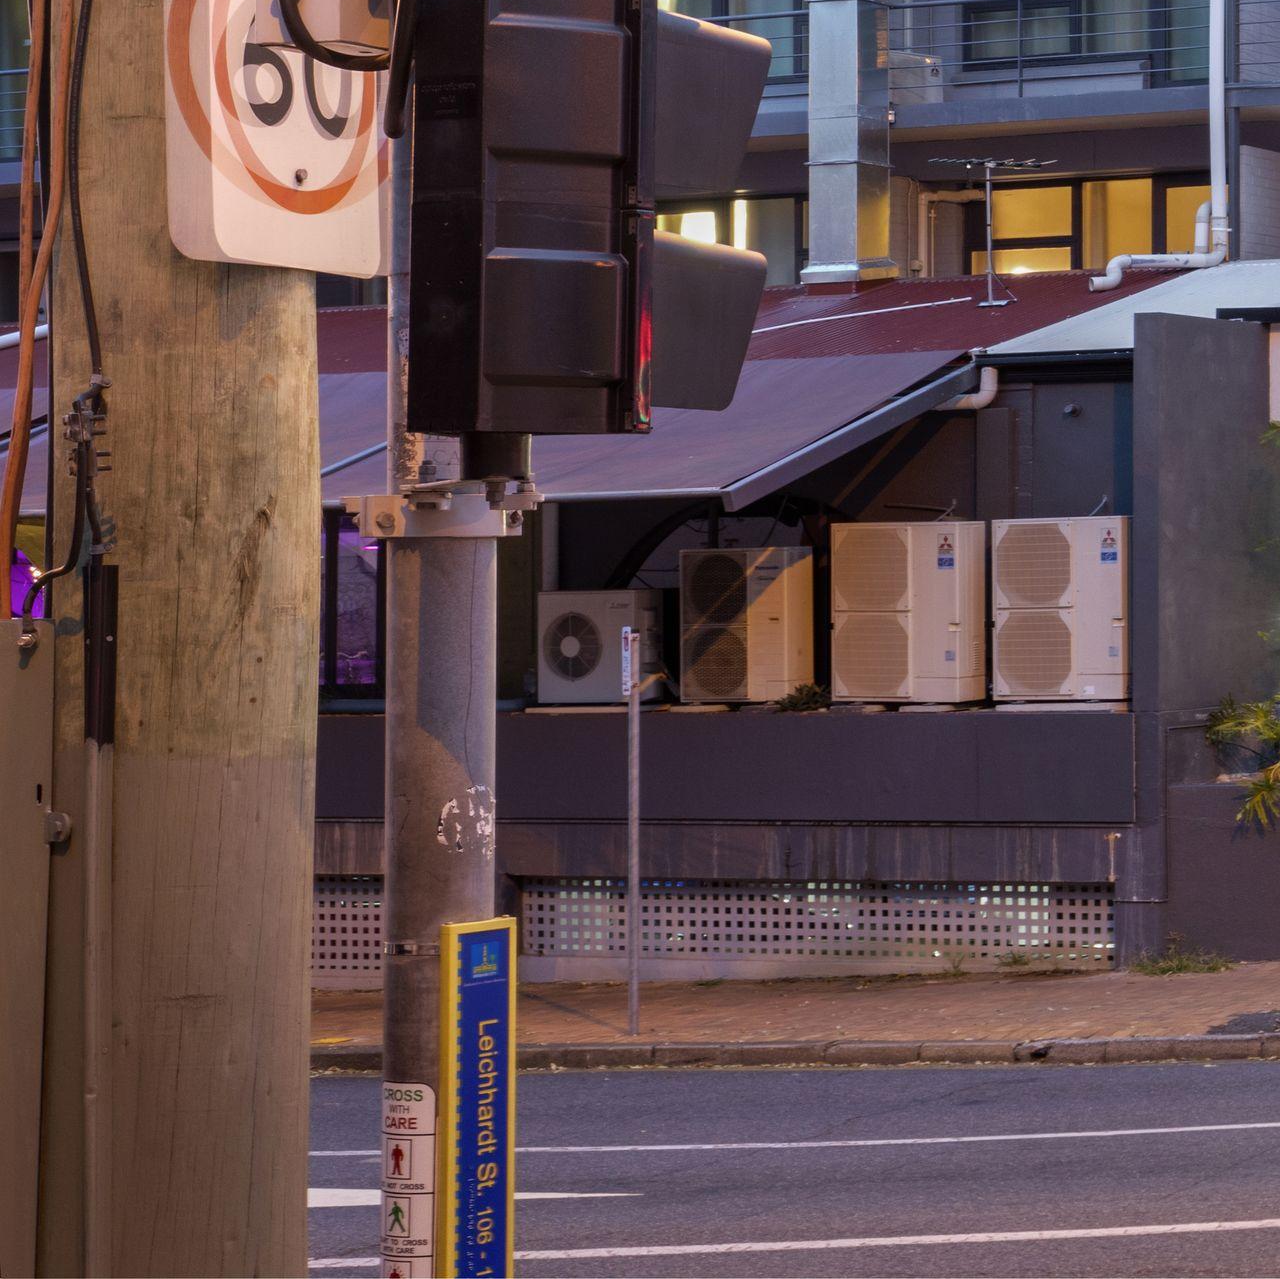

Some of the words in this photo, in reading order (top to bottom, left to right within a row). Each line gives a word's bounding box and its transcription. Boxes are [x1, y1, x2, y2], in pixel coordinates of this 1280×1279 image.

[477, 1018, 499, 1156] Leichhardt
[383, 1088, 424, 1102] CROSS
[384, 1116, 418, 1130] CARE
[477, 1162, 498, 1197] St.
[399, 1183, 425, 1191] CROSS
[476, 1206, 494, 1245] 106
[395, 1247, 416, 1255] CARE
